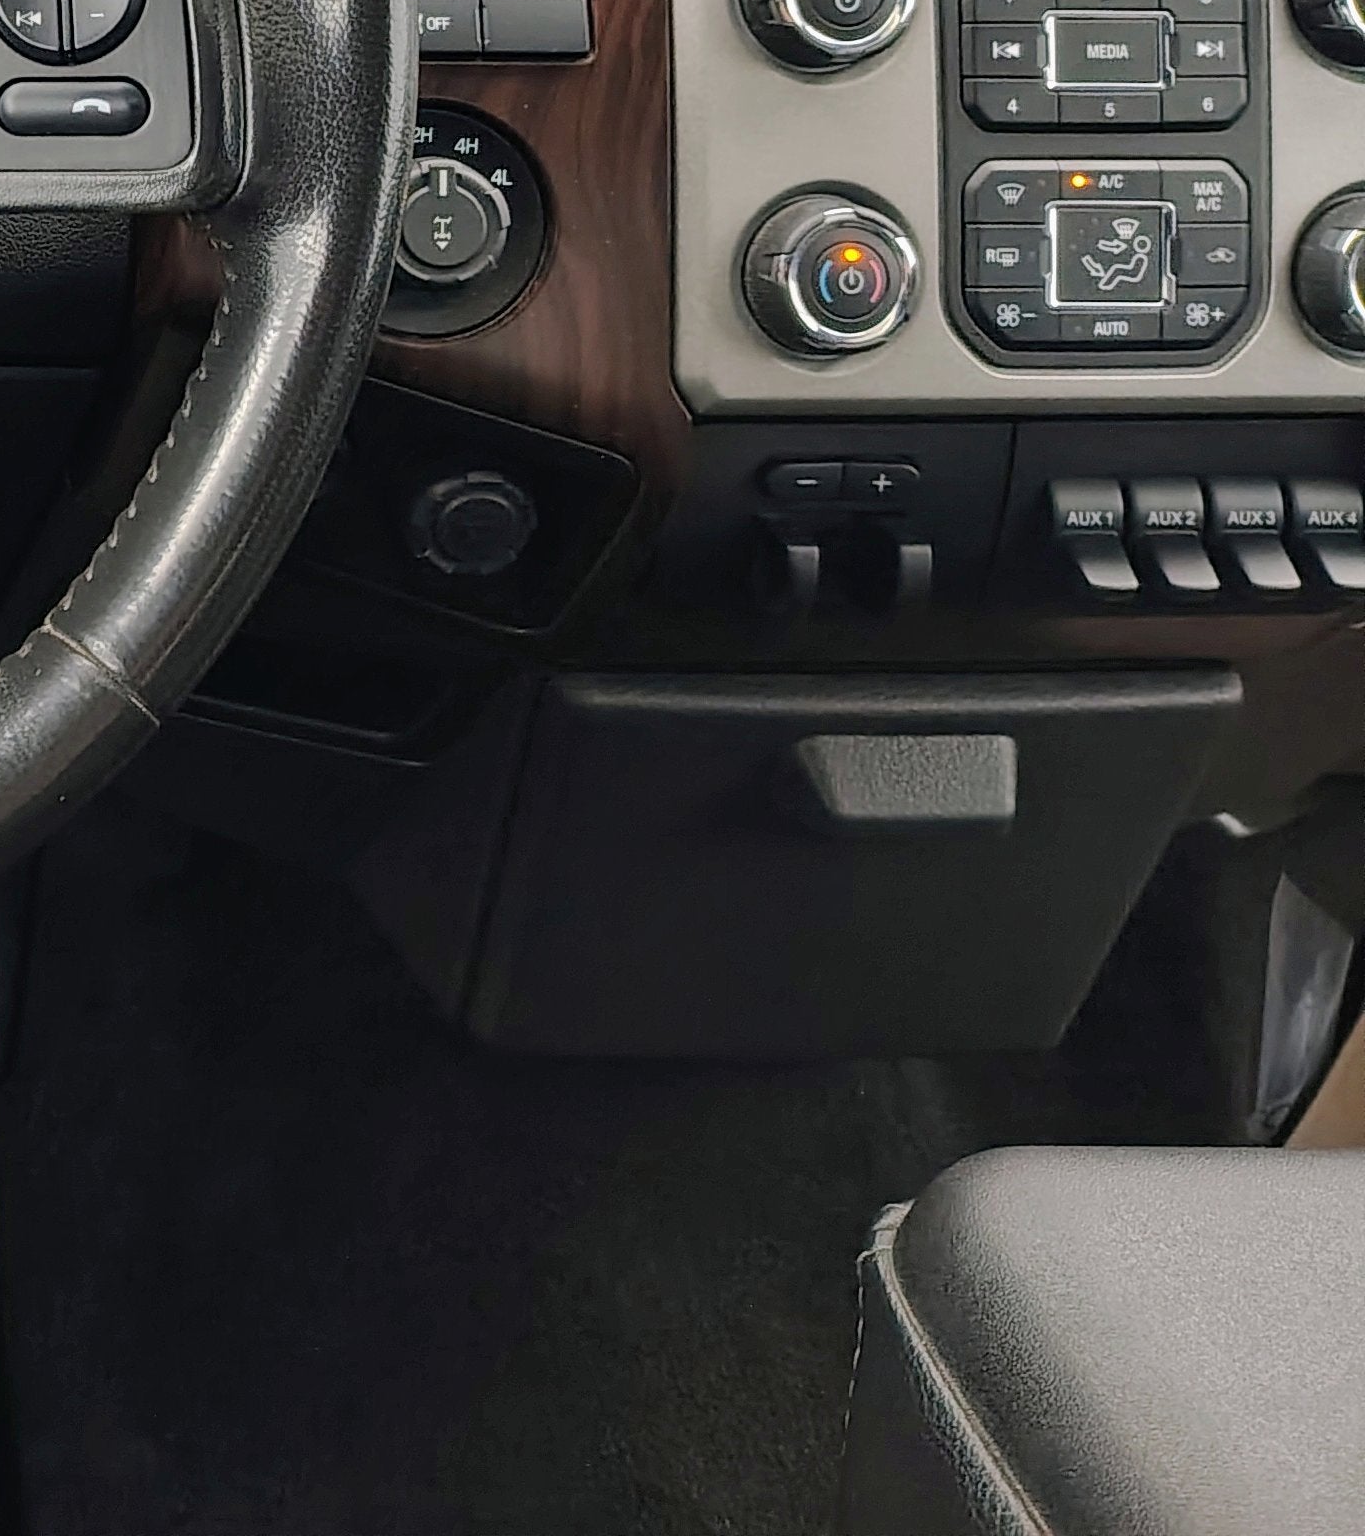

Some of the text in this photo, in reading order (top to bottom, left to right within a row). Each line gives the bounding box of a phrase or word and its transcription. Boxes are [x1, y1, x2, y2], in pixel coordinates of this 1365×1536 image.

[425, 16, 451, 32] OFF
[1085, 43, 1130, 61] MEDIA
[1005, 98, 1020, 115] 4
[1103, 102, 1117, 118] 5
[1201, 96, 1215, 113] 6
[413, 126, 434, 144] 2H
[453, 137, 480, 156] 4H
[490, 168, 514, 187] 4L
[1097, 174, 1125, 190] A/C
[1192, 181, 1225, 197] MAX
[1194, 197, 1223, 213] A/C
[1093, 320, 1130, 337] AUTO
[1066, 510, 1115, 527] AUX 1
[1146, 510, 1198, 527] AUX 2
[1226, 510, 1277, 527] AUX 3
[1307, 510, 1359, 526] AUX 4
